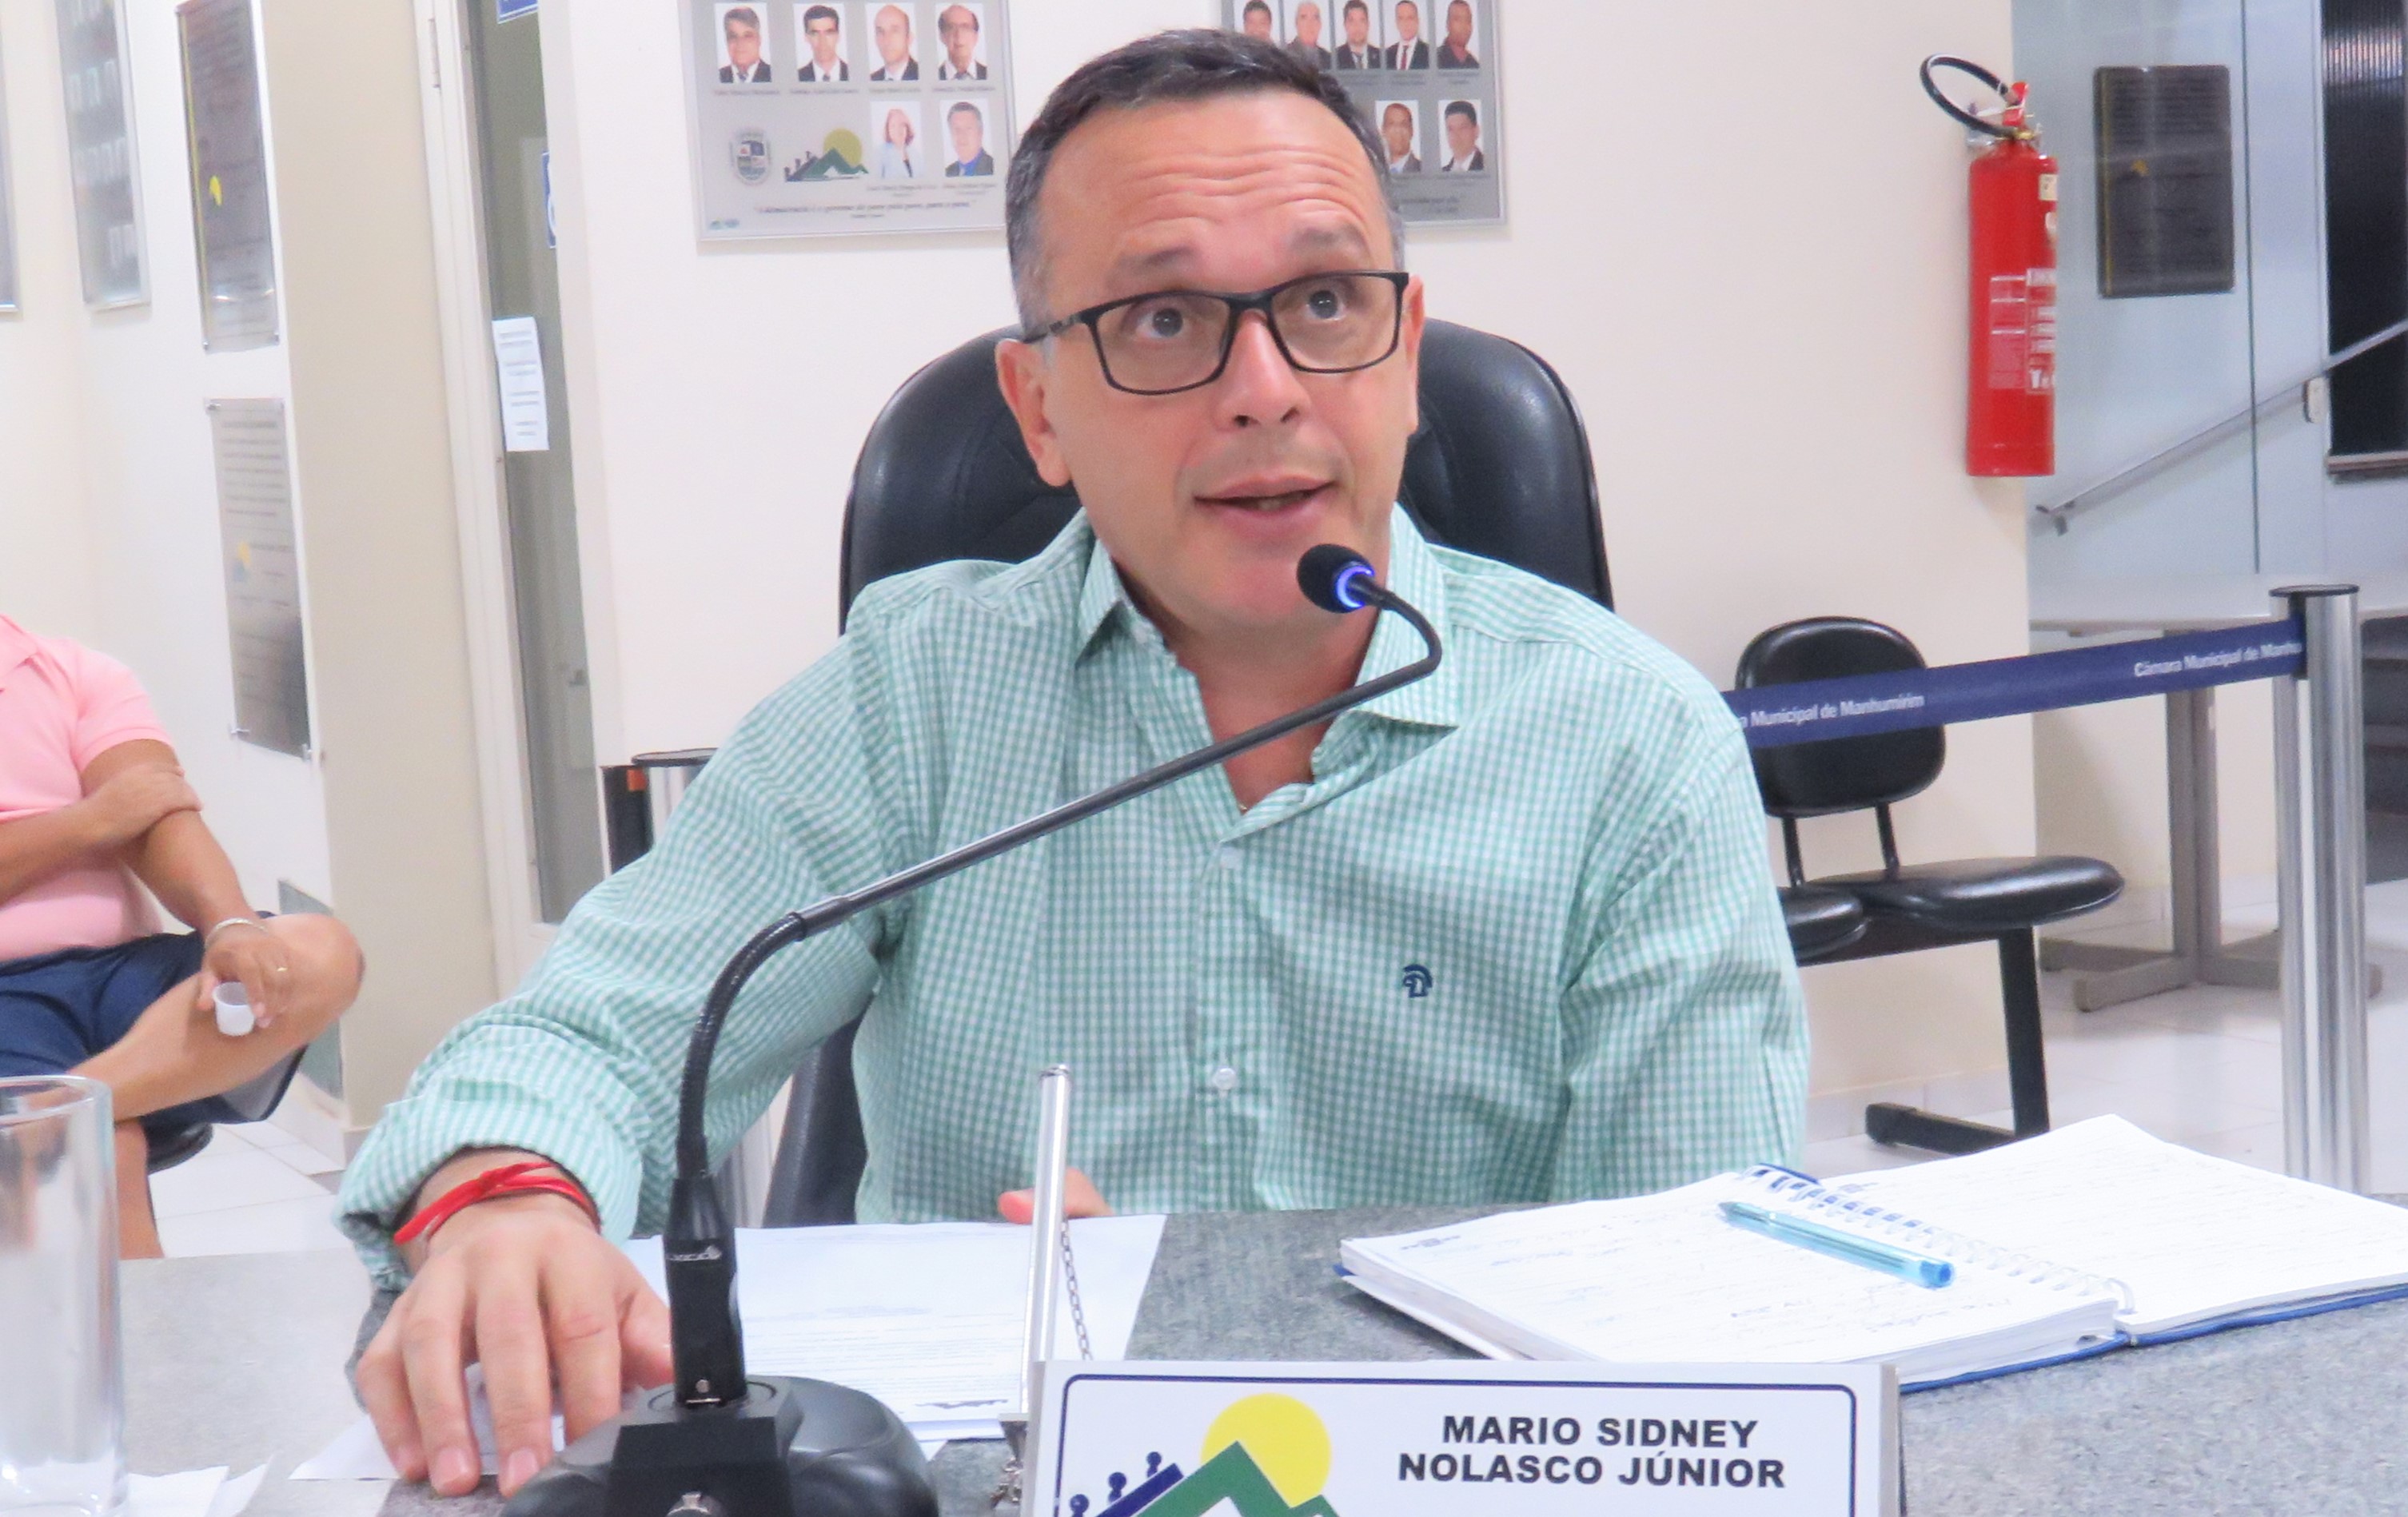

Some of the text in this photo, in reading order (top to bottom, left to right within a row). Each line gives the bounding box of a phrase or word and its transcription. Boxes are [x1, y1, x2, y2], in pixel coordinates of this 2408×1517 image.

[2184, 648, 2243, 668] Municipal
[2243, 647, 2259, 662] de
[1751, 704, 1819, 727] Municipal
[1820, 703, 1838, 719] de
[1840, 693, 1924, 716] Manhumirim
[1442, 1415, 1758, 1448] MARIO SIDNEY
[1398, 1451, 1786, 1488] NOLASCO JÚNIOR
